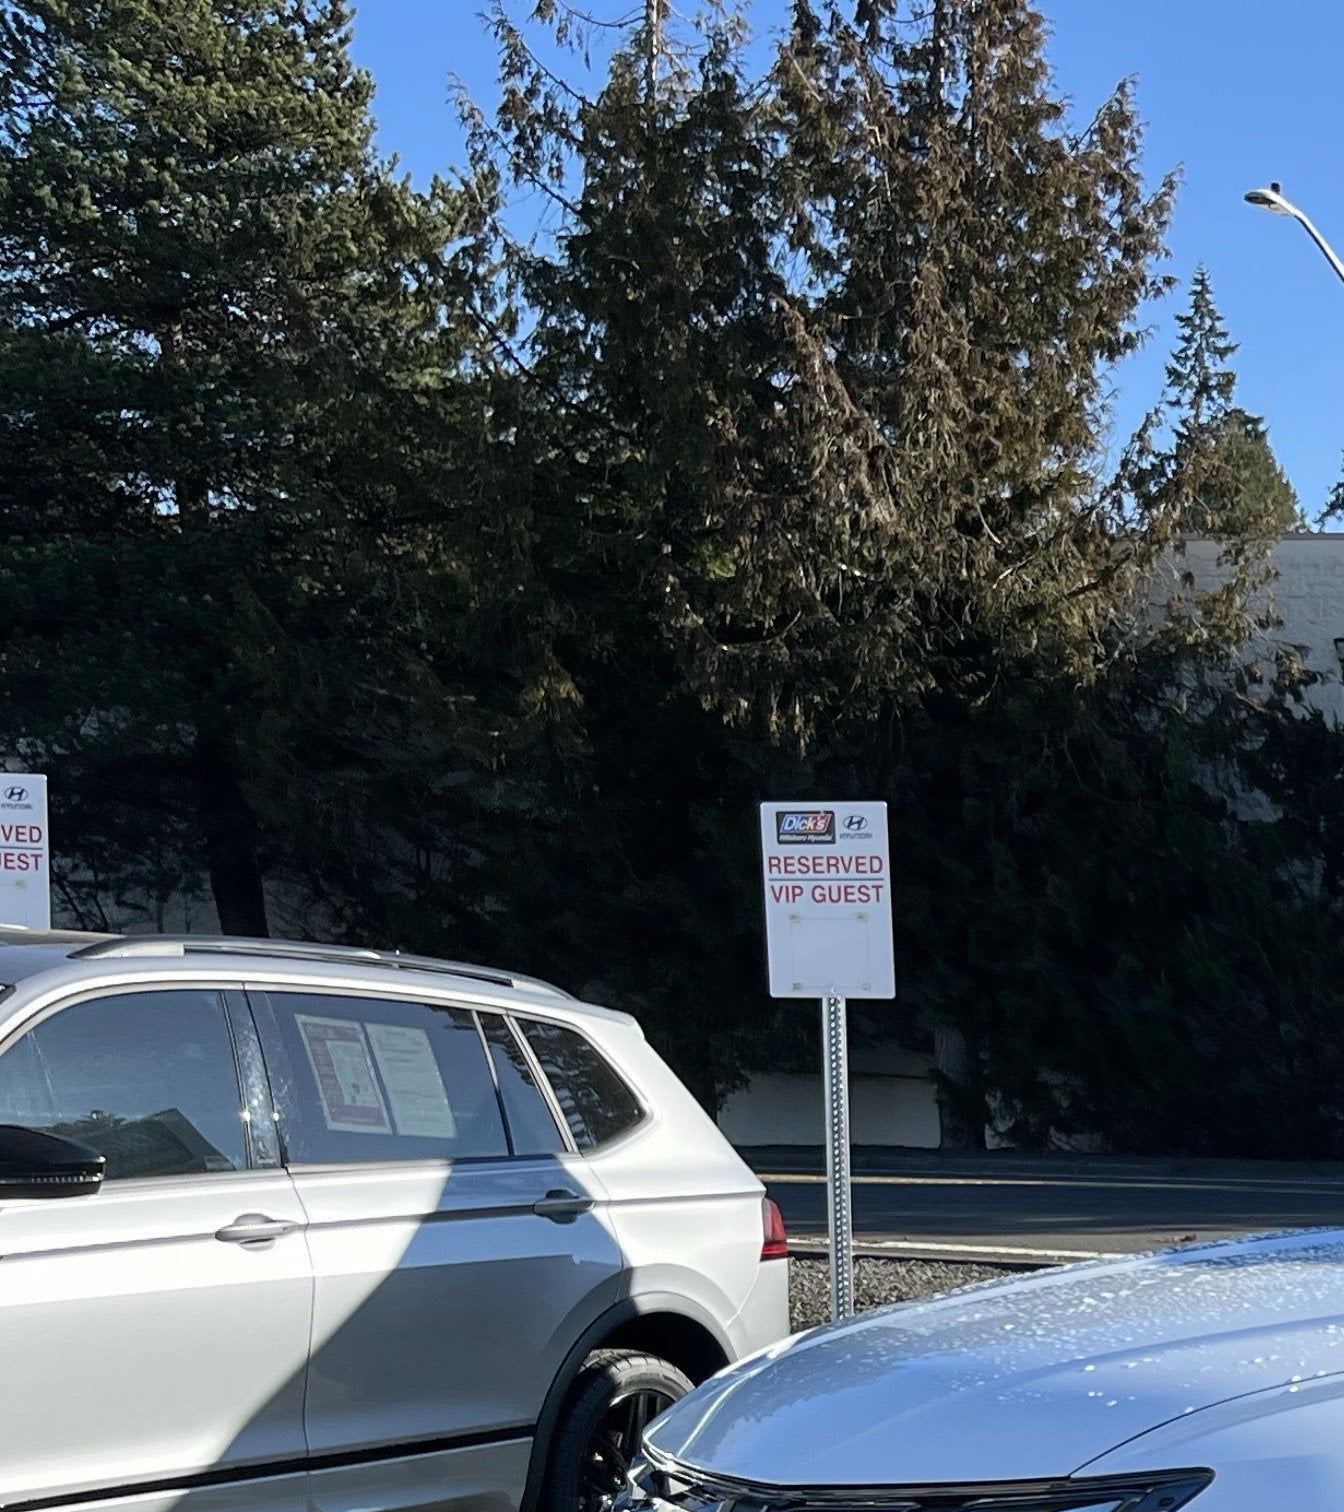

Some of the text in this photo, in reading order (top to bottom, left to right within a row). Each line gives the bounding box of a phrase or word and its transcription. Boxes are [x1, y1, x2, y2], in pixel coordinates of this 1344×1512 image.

[0, 852, 43, 872] EST
[768, 855, 883, 875] RESERVED
[771, 884, 884, 904] VIP GUEST
